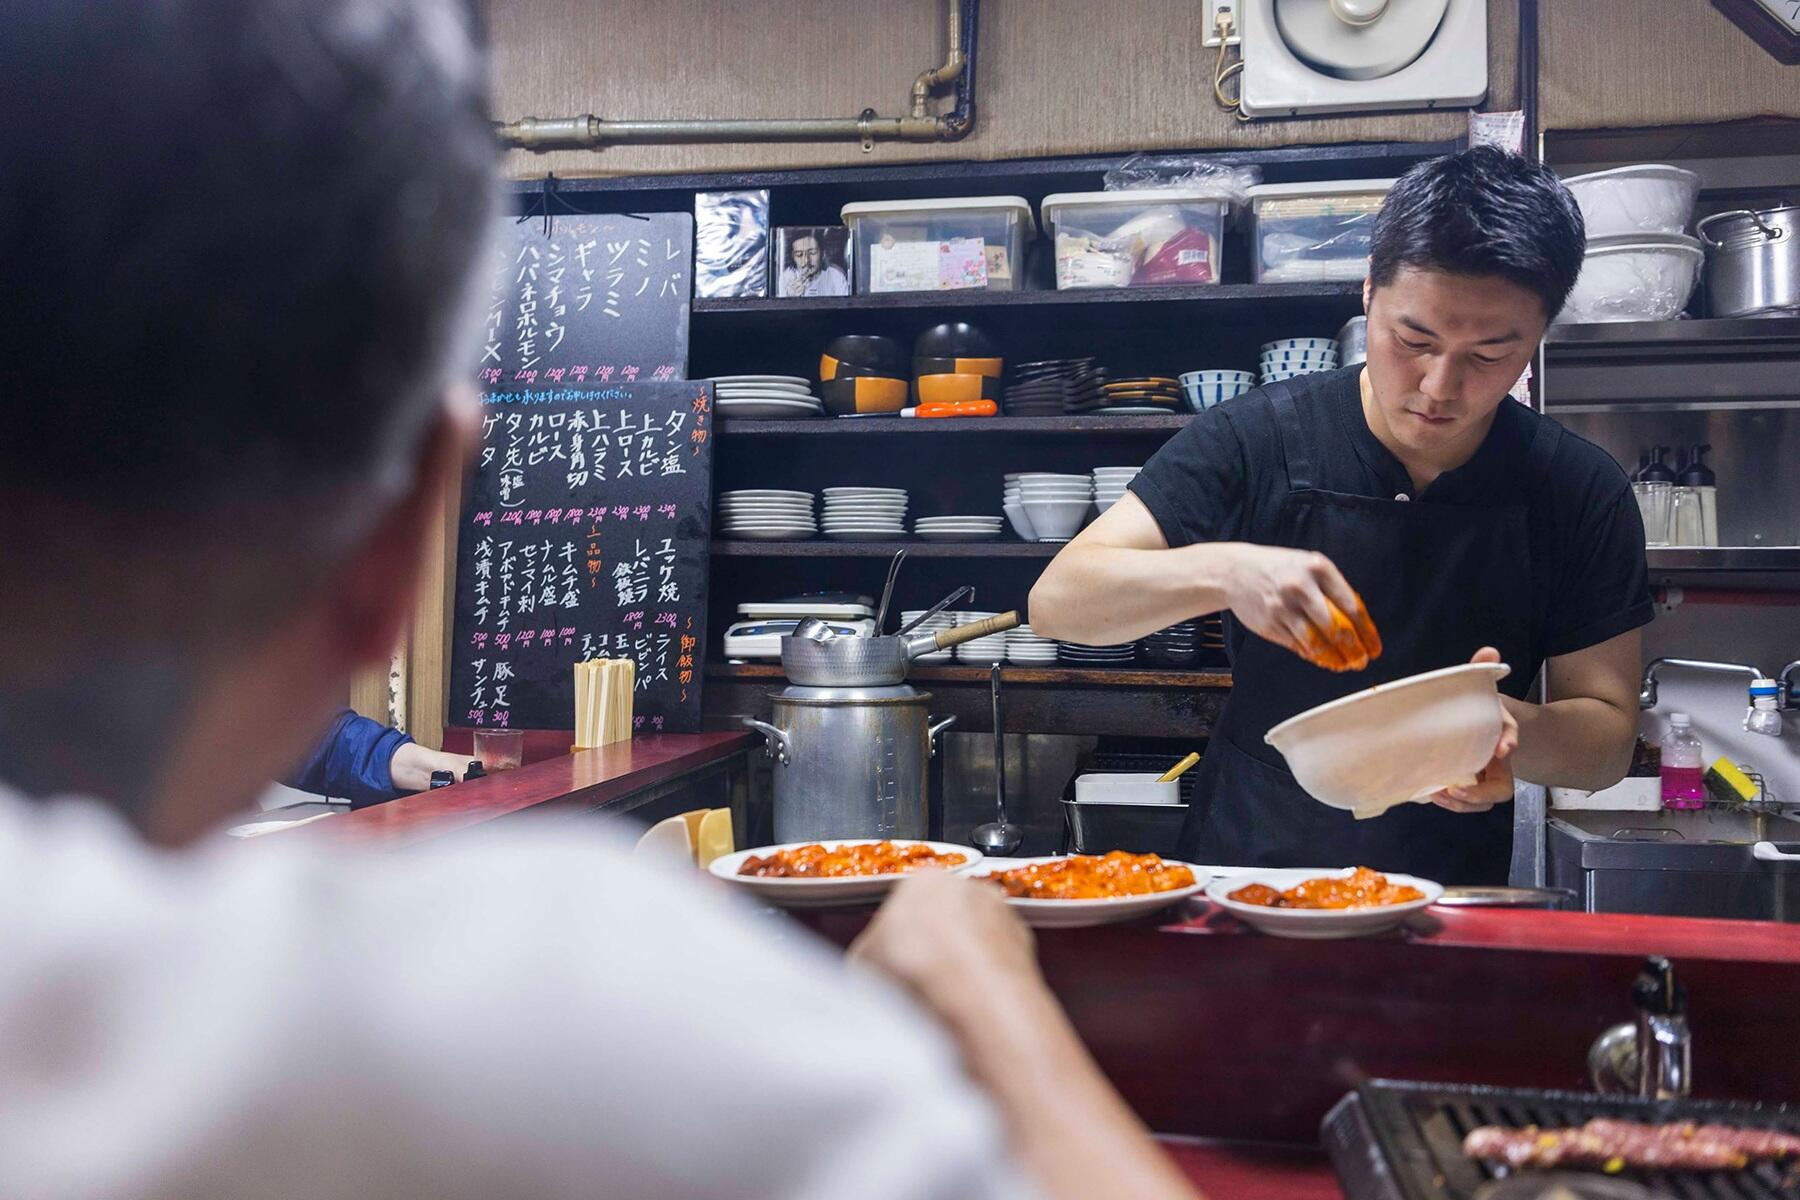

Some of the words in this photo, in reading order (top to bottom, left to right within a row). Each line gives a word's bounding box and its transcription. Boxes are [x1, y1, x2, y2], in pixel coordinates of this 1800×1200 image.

[544, 243, 566, 352] シマチョウ
[575, 239, 597, 311] ギャラ
[603, 239, 630, 317] ツラミ
[635, 238, 651, 296] ミノ
[660, 238, 681, 297] レバ
[516, 245, 541, 370] ハバネロホルモン
[480, 411, 503, 468] ゲタ
[527, 413, 551, 466] カルビ
[548, 412, 567, 462] ロース
[587, 408, 611, 481] 上ハラミ
[612, 408, 637, 479] 上ロース
[635, 412, 663, 476] 上カルビ
[660, 409, 687, 477] タン塩
[517, 544, 538, 614] センマイ刺
[538, 539, 558, 607] ナムル盛
[558, 541, 581, 609] キムチ盛
[655, 538, 681, 603] ユッケ焼
[470, 658, 488, 709] サンチュ
[490, 661, 516, 709] 豚足
[634, 632, 653, 692] ビビンパ
[655, 633, 671, 681] ライス
